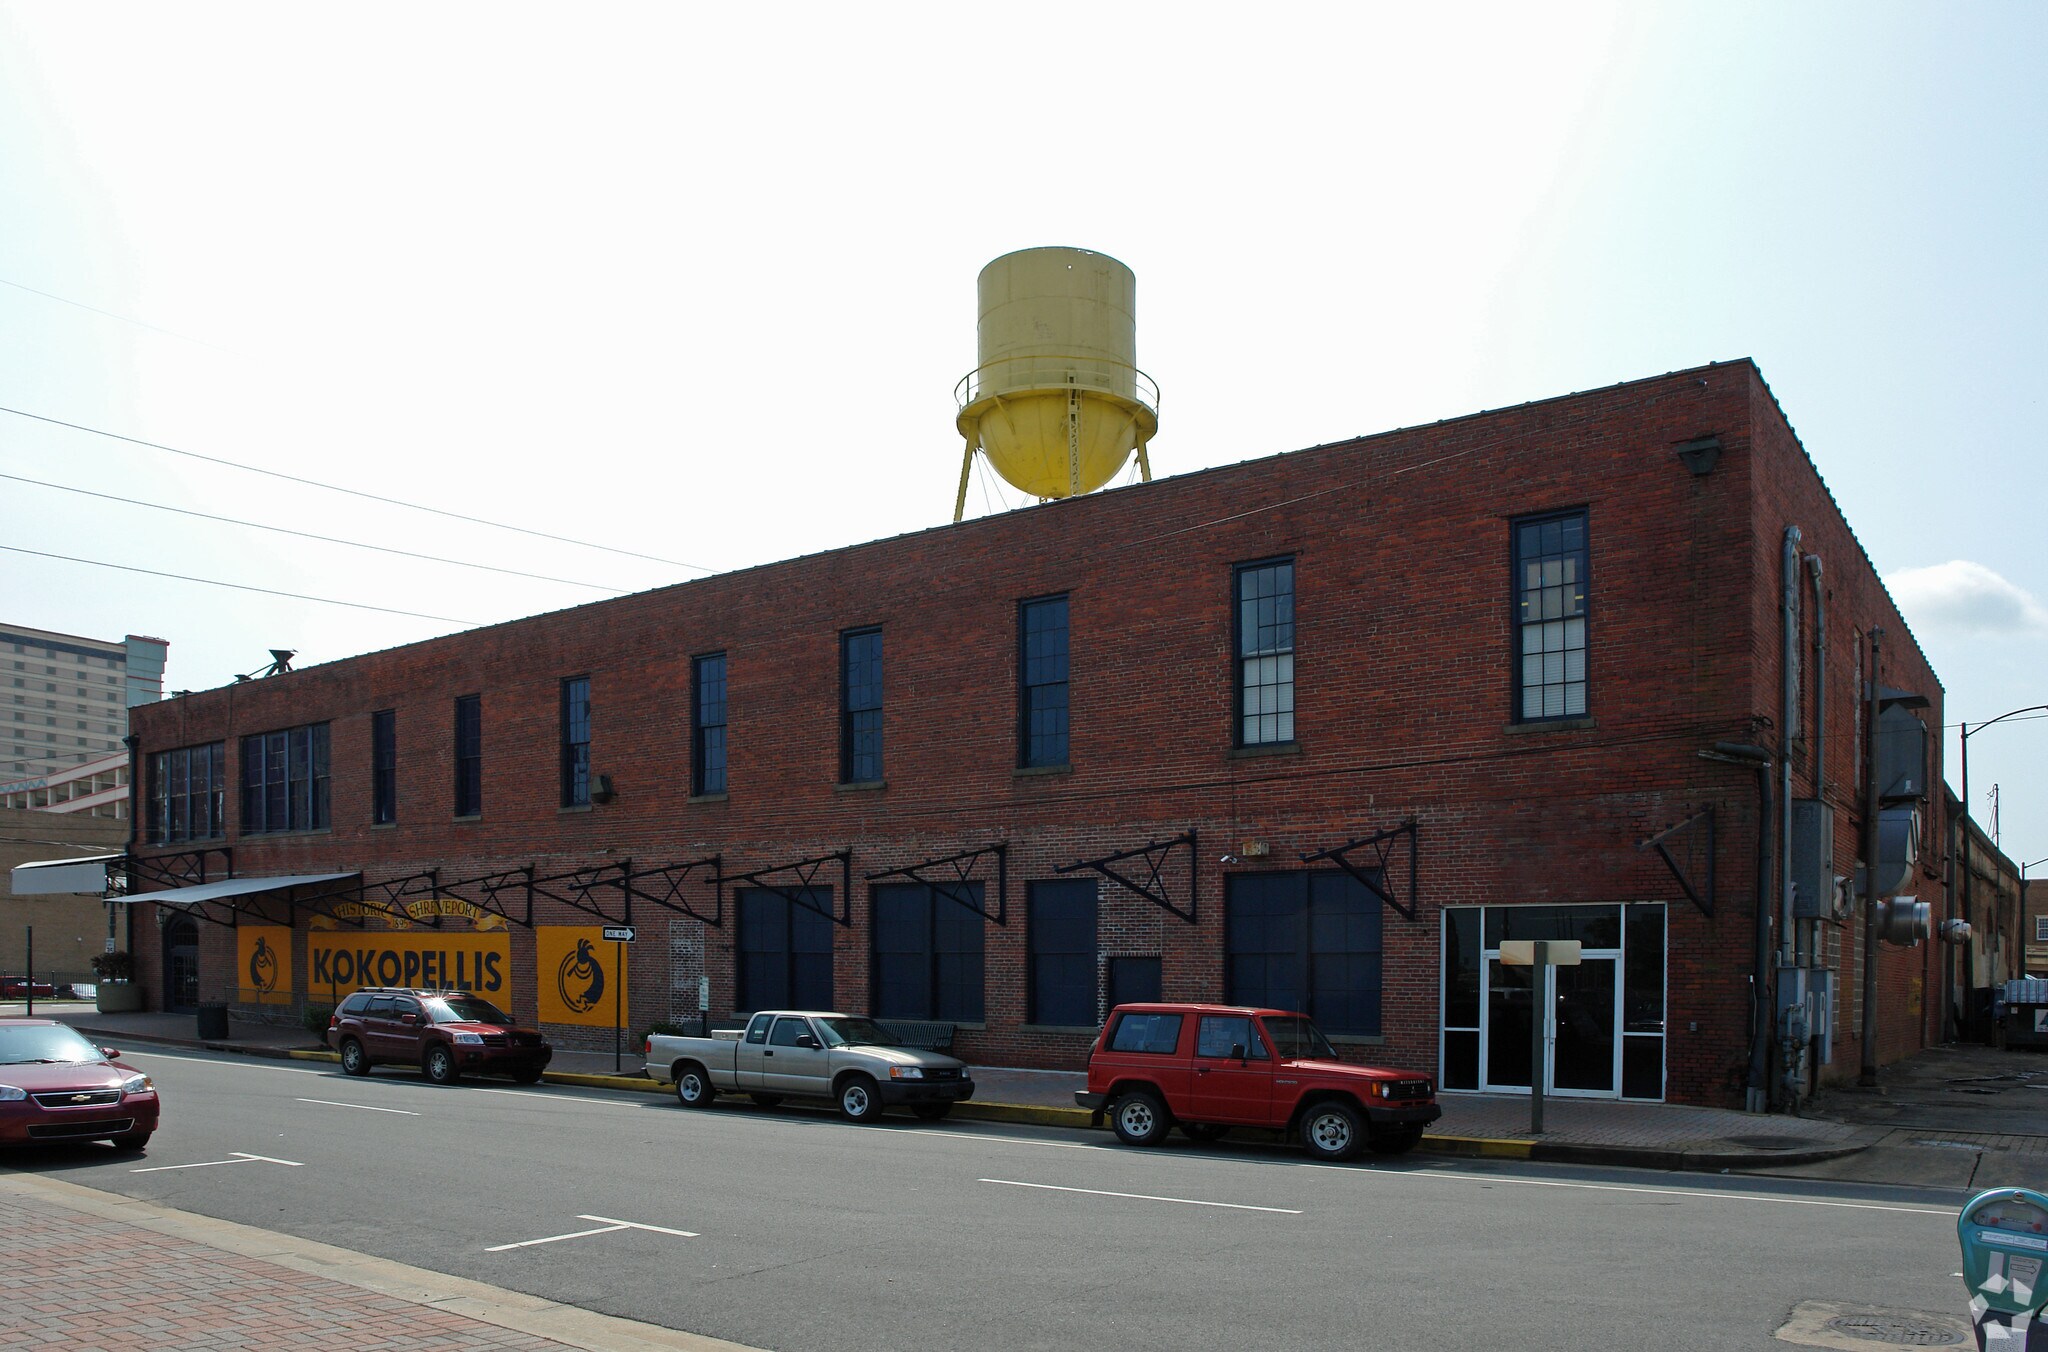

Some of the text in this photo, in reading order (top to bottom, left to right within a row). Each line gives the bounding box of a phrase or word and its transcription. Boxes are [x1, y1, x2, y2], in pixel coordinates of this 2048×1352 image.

[337, 901, 480, 918] HISTORIC SHREVEPORT
[392, 918, 409, 928] 1895
[618, 930, 628, 938] WAY
[314, 949, 502, 992] KOKOPELLIS
